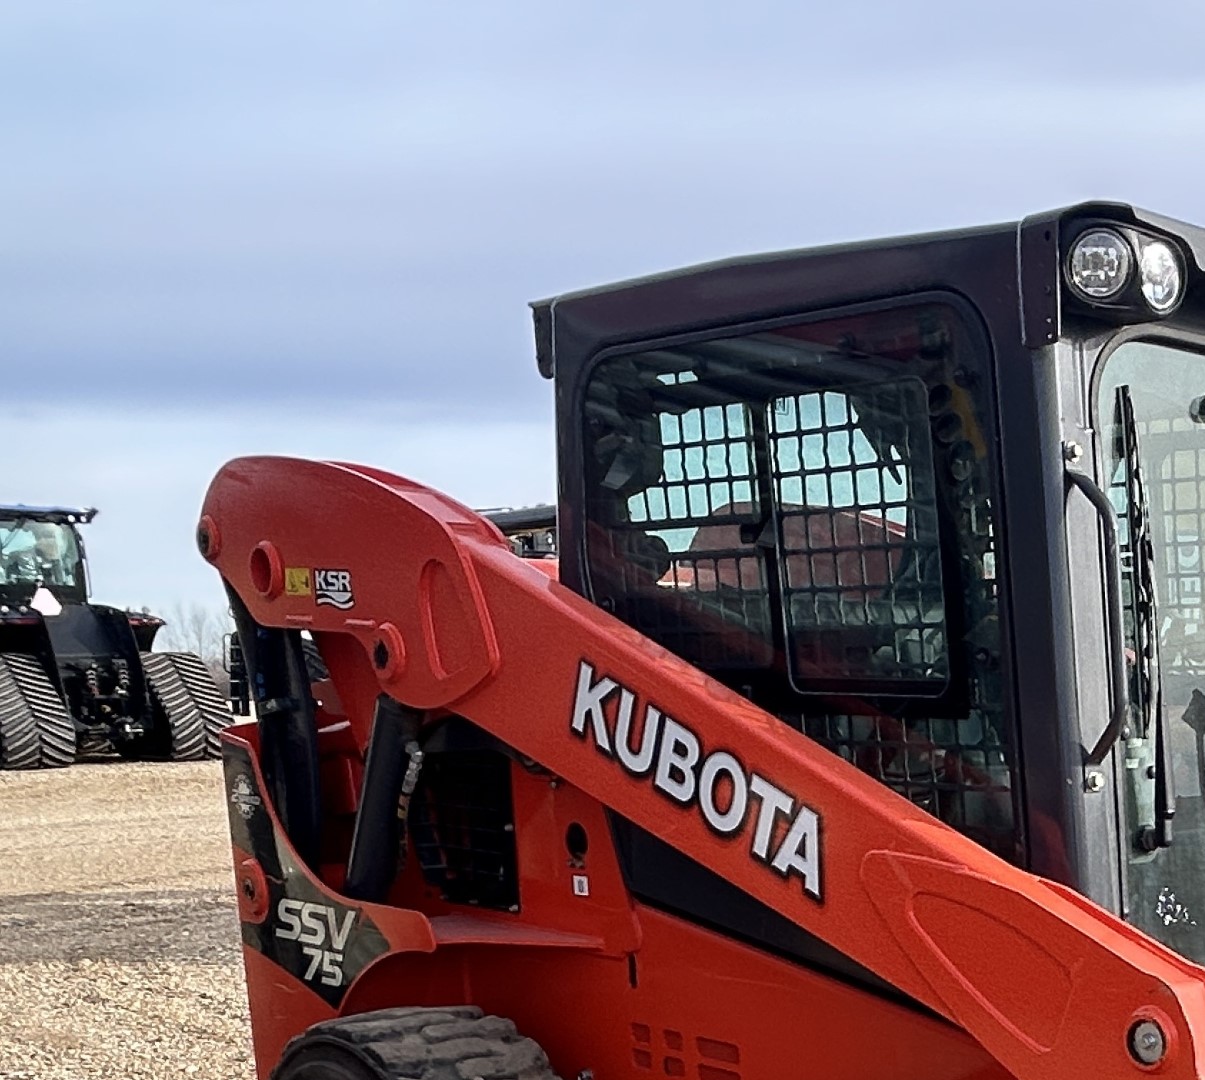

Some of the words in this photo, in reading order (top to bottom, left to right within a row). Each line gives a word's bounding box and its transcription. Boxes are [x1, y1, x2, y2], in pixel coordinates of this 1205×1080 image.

[315, 570, 351, 591] KSR
[571, 660, 821, 899] KUBOTA
[276, 898, 356, 950] SSV
[303, 947, 343, 987] 75
